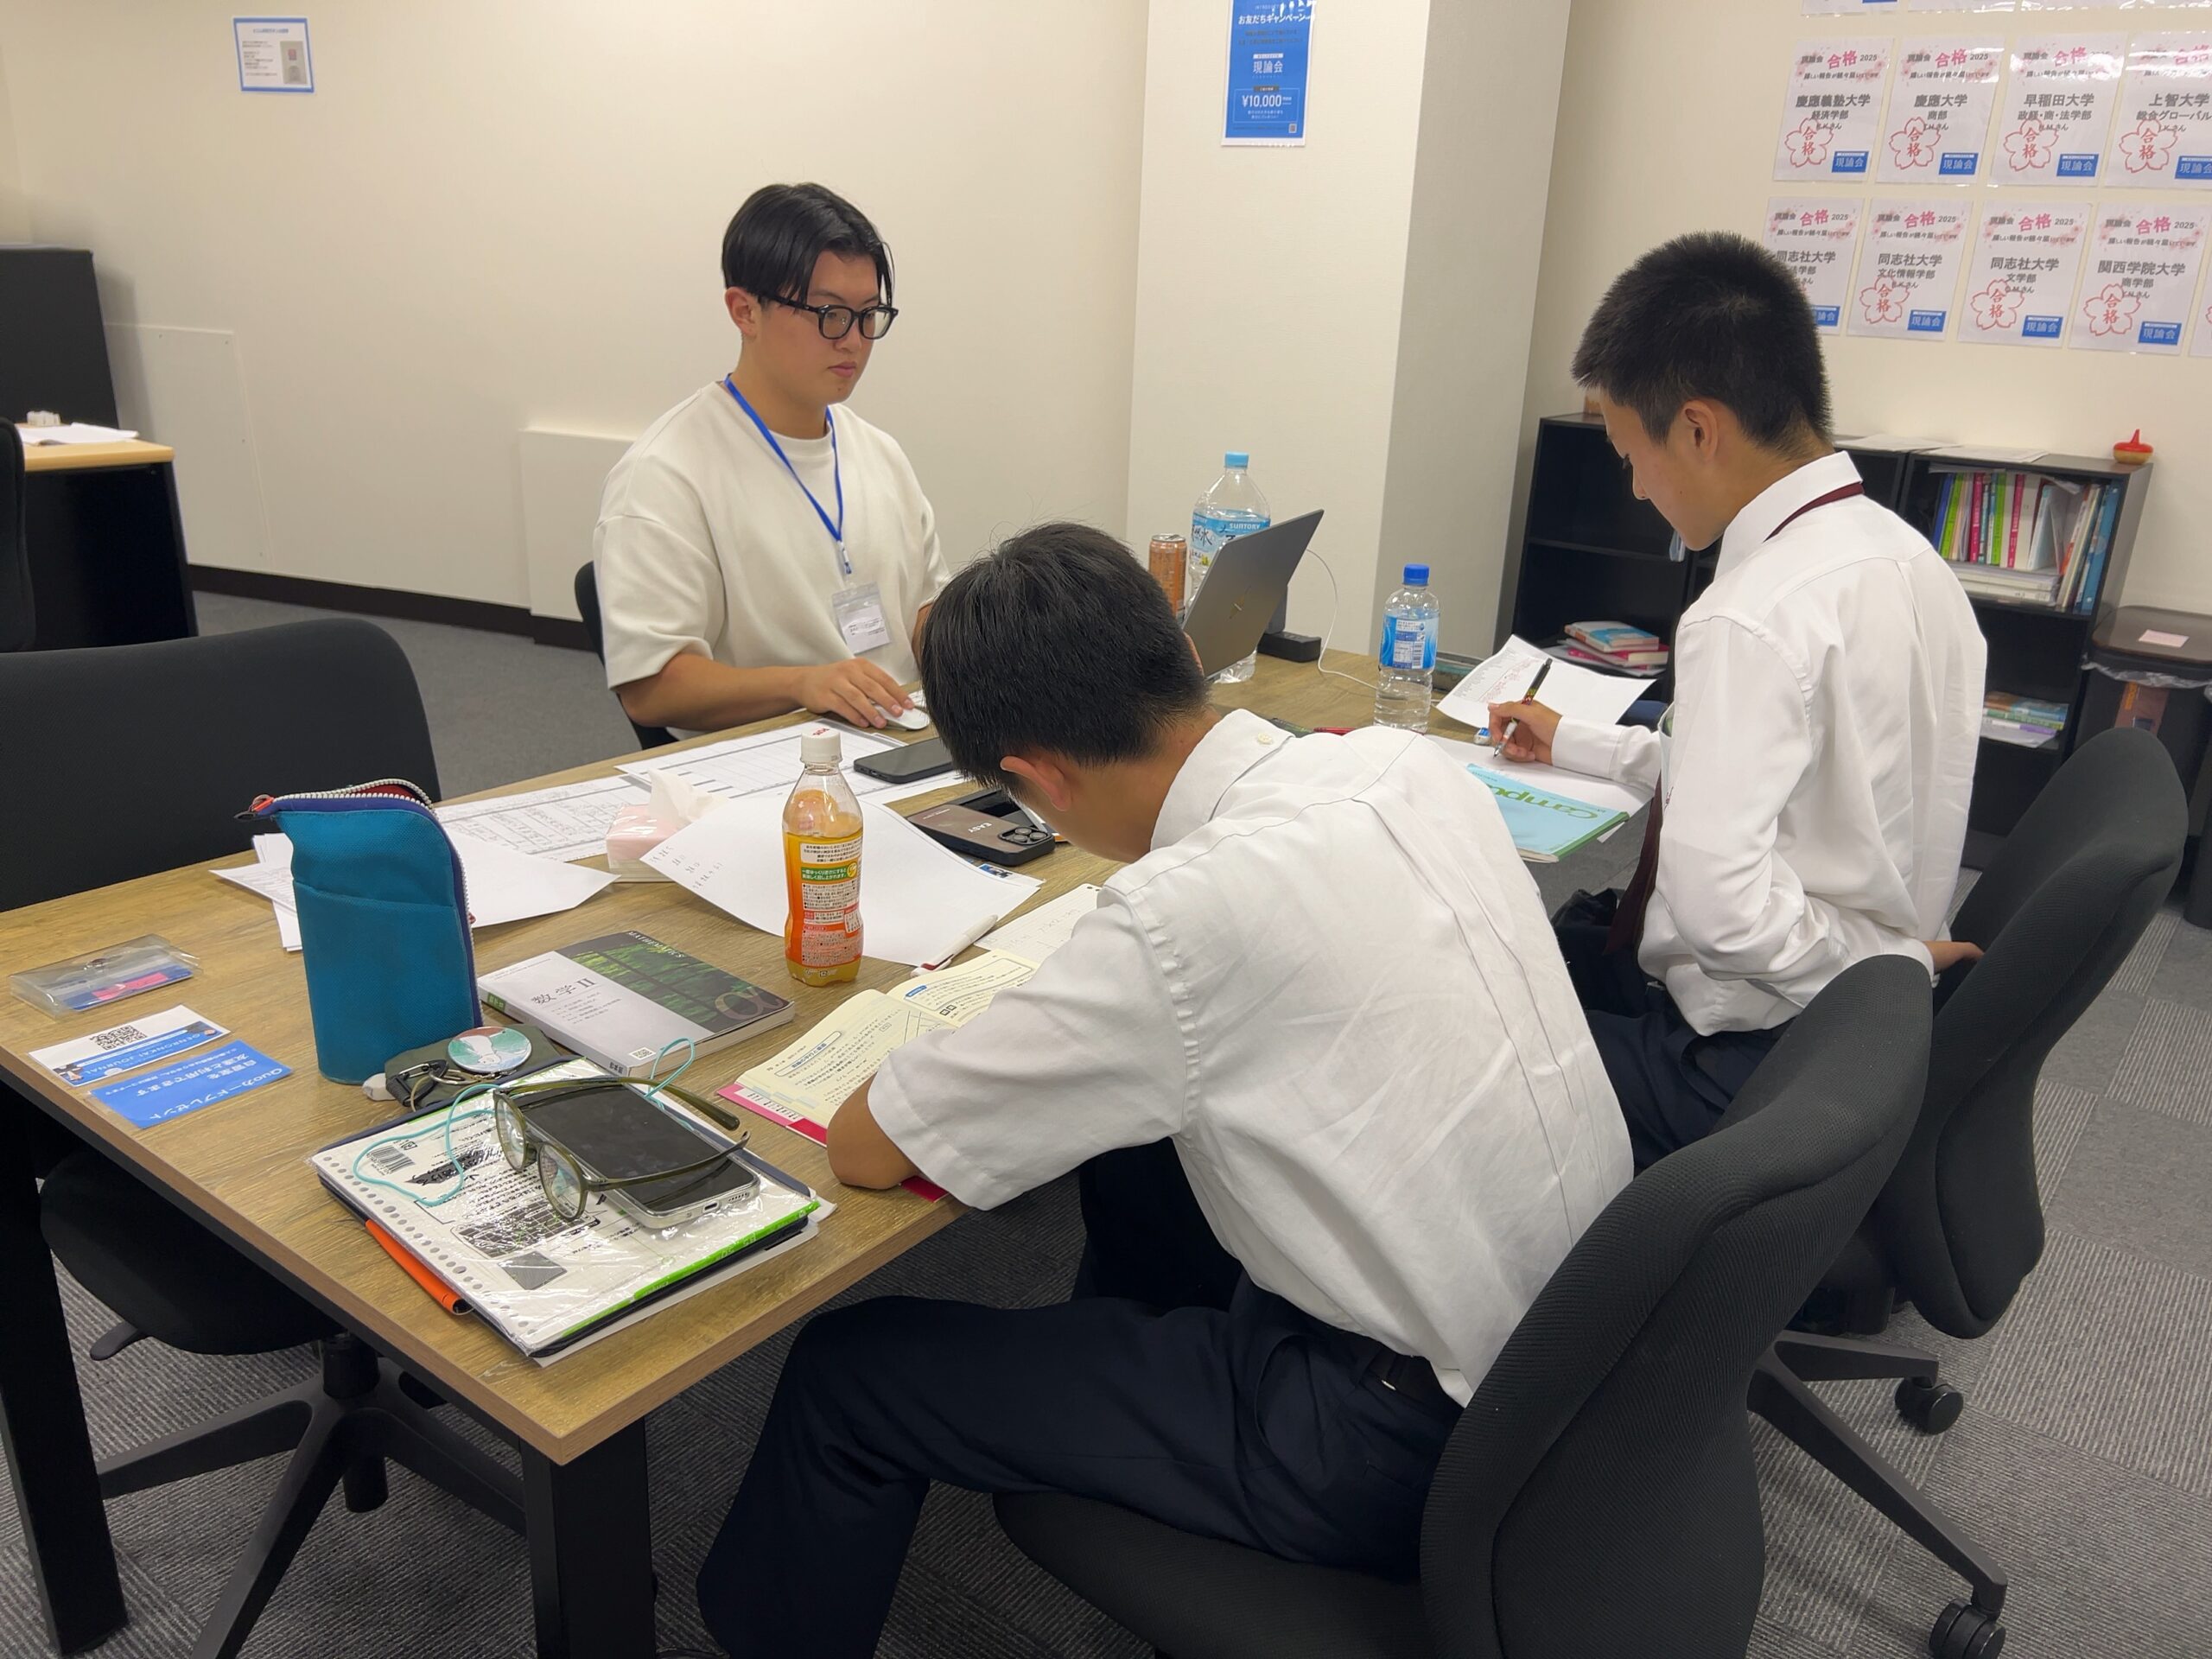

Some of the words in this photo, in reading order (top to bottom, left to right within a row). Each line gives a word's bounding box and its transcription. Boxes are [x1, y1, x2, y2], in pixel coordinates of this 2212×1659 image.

[1827, 50, 1858, 70] 合格
[1935, 48, 1967, 69] 合格
[1253, 60, 1283, 73] 現論会
[1242, 95, 1281, 108] ¥10,000
[1796, 93, 1871, 108] 慶應義塾大学
[1914, 93, 1967, 108] 慶應大学
[2024, 93, 2094, 108] 早稲田大学
[2148, 92, 2210, 107] 上智大学
[1810, 110, 1849, 120] 経済学部
[2017, 110, 2093, 121] 政経・商・法学部
[1802, 126, 1817, 156] 合格
[1907, 126, 1923, 157] 合格
[2023, 127, 2040, 159] 合格
[2139, 128, 2158, 160] 合格
[2061, 161, 2094, 171] 現論会
[1800, 209, 1829, 227] 合格
[1904, 210, 1936, 229] 合格
[2018, 213, 2052, 232] 合格
[2136, 216, 2171, 235] 合格
[1776, 250, 1836, 264] 同志社大学
[1877, 252, 1942, 267] 同志社大学
[1990, 257, 2060, 271] 同志社大学
[1877, 269, 1936, 279] 文化情報学部
[2097, 260, 2186, 276] 関西学院大学
[2005, 273, 2037, 283] 文学部
[2121, 277, 2154, 289] 商学部
[1877, 283, 1892, 313] 合格
[1989, 289, 2006, 318] 合格
[1814, 312, 1835, 321] 論会
[2103, 293, 2121, 325] 合格
[2026, 321, 2058, 333] 現論会
[2143, 328, 2176, 339] 現論会
[1229, 523, 1261, 531] SUNTORY
[1486, 784, 1599, 820] Campu
[137, 1053, 250, 1097] 友達と利用できます
[207, 1059, 257, 1079] 自習室を
